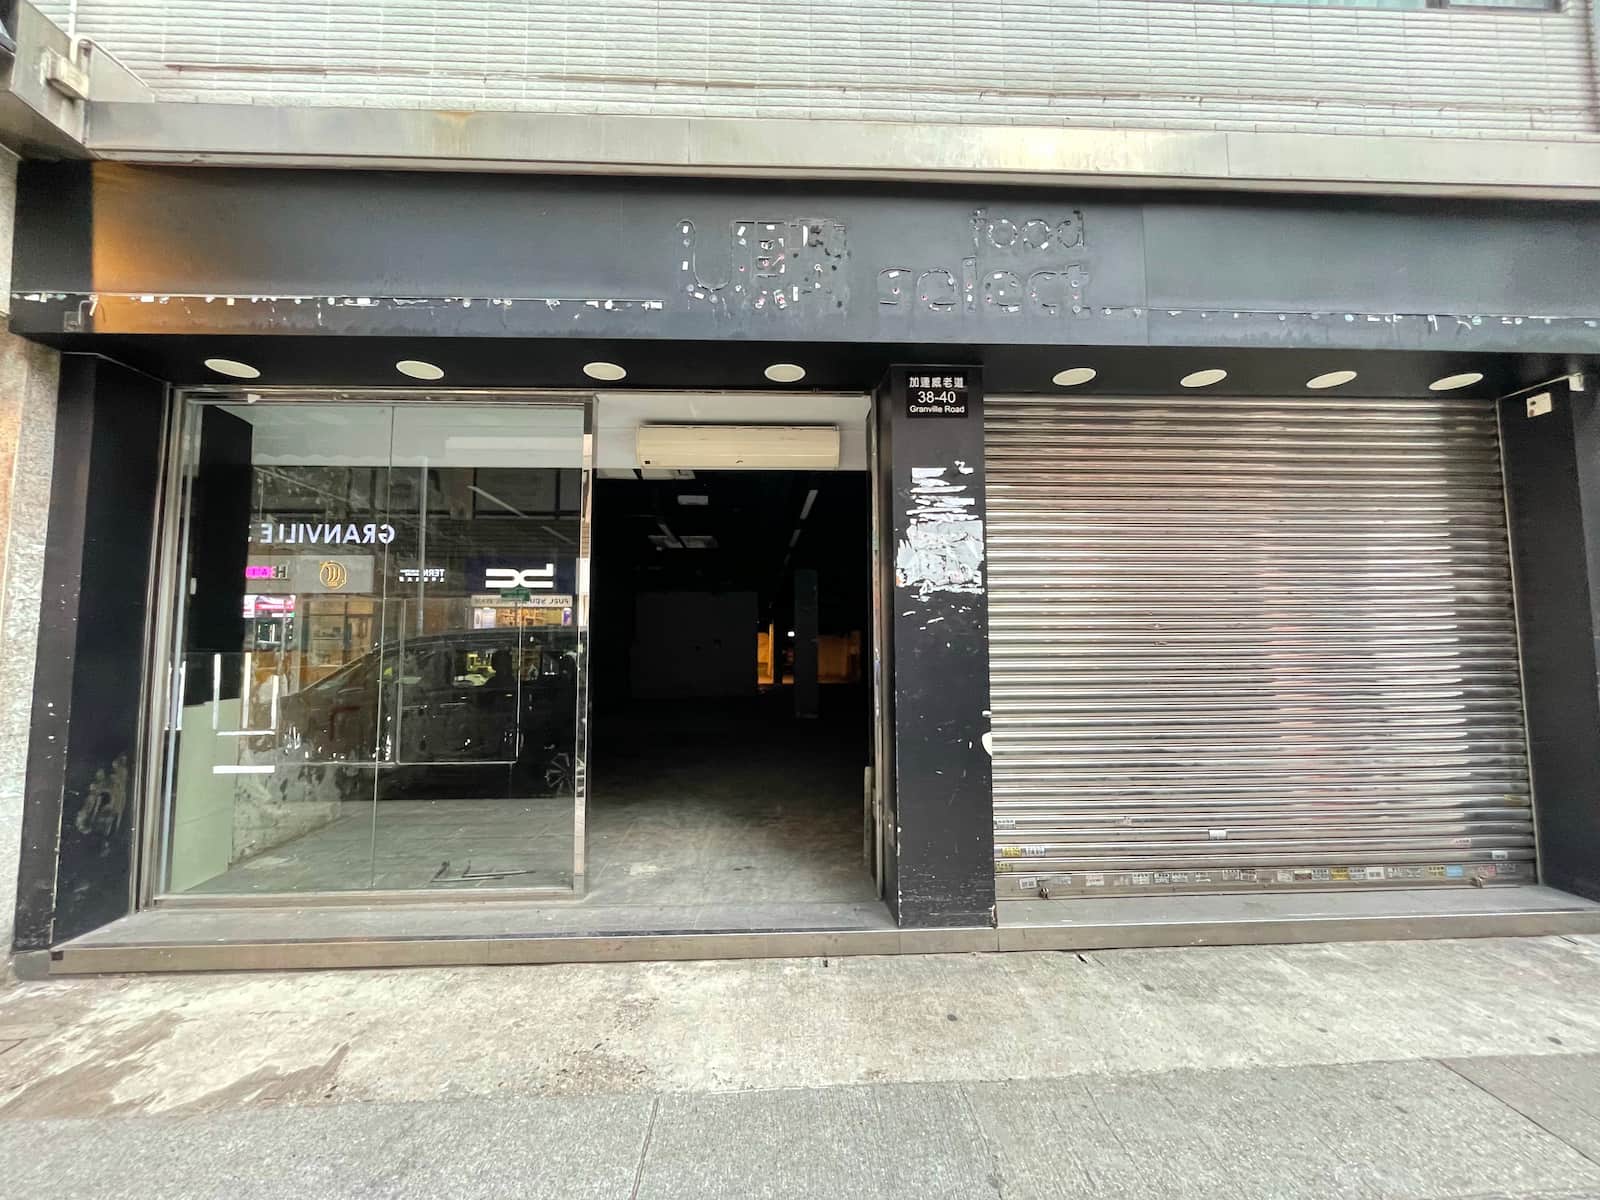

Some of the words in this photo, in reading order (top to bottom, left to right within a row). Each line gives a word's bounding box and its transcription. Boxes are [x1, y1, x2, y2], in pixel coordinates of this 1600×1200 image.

[969, 208, 1085, 250] food
[877, 256, 1091, 315] select
[909, 405, 943, 413] Granville
[944, 405, 965, 413] Road
[917, 390, 956, 403] 38-40
